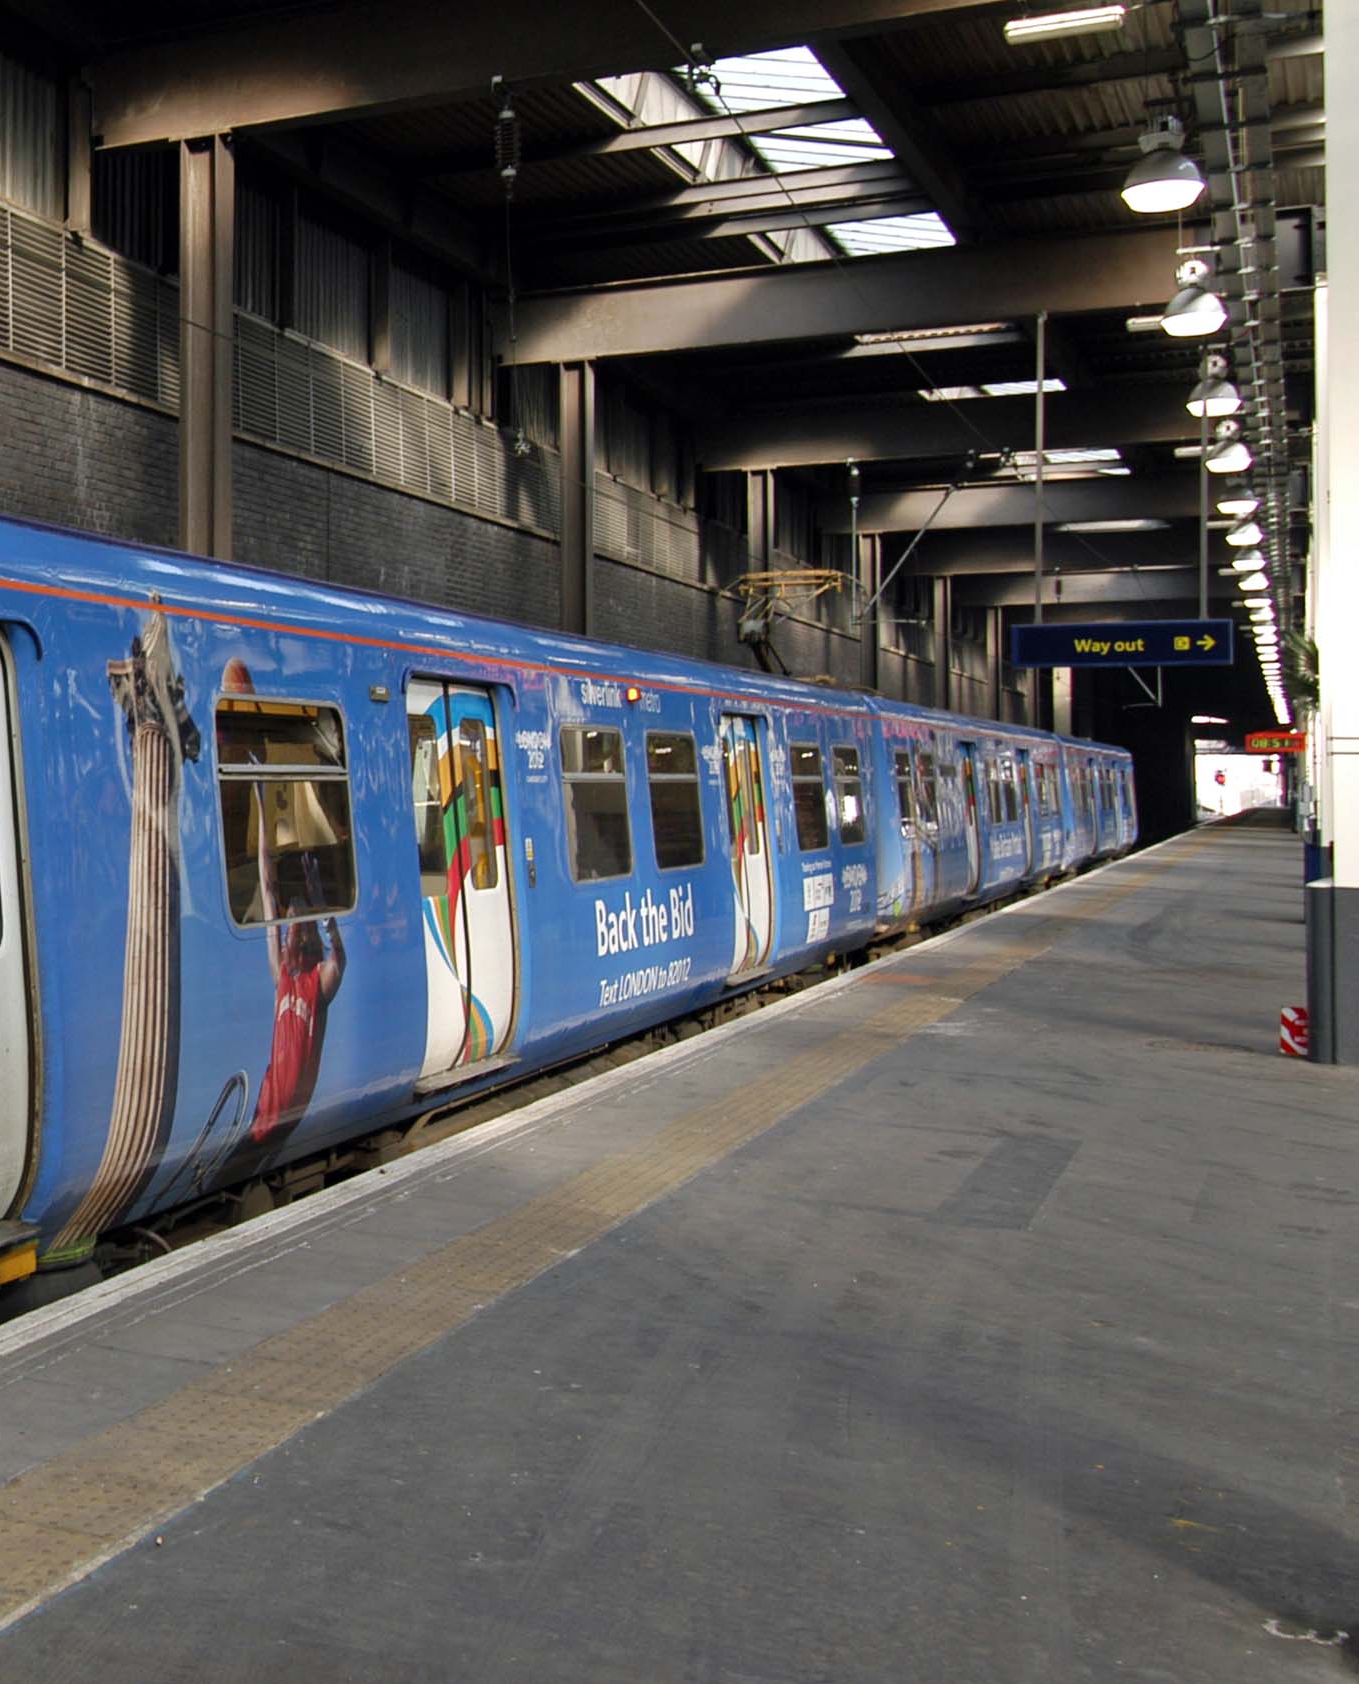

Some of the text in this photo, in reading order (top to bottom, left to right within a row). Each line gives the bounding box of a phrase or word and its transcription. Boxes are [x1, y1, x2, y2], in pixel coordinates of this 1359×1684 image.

[1073, 638, 1145, 655] Way out
[595, 882, 694, 957] Back the Bid
[599, 957, 691, 1007] Text LONDON to 82012
